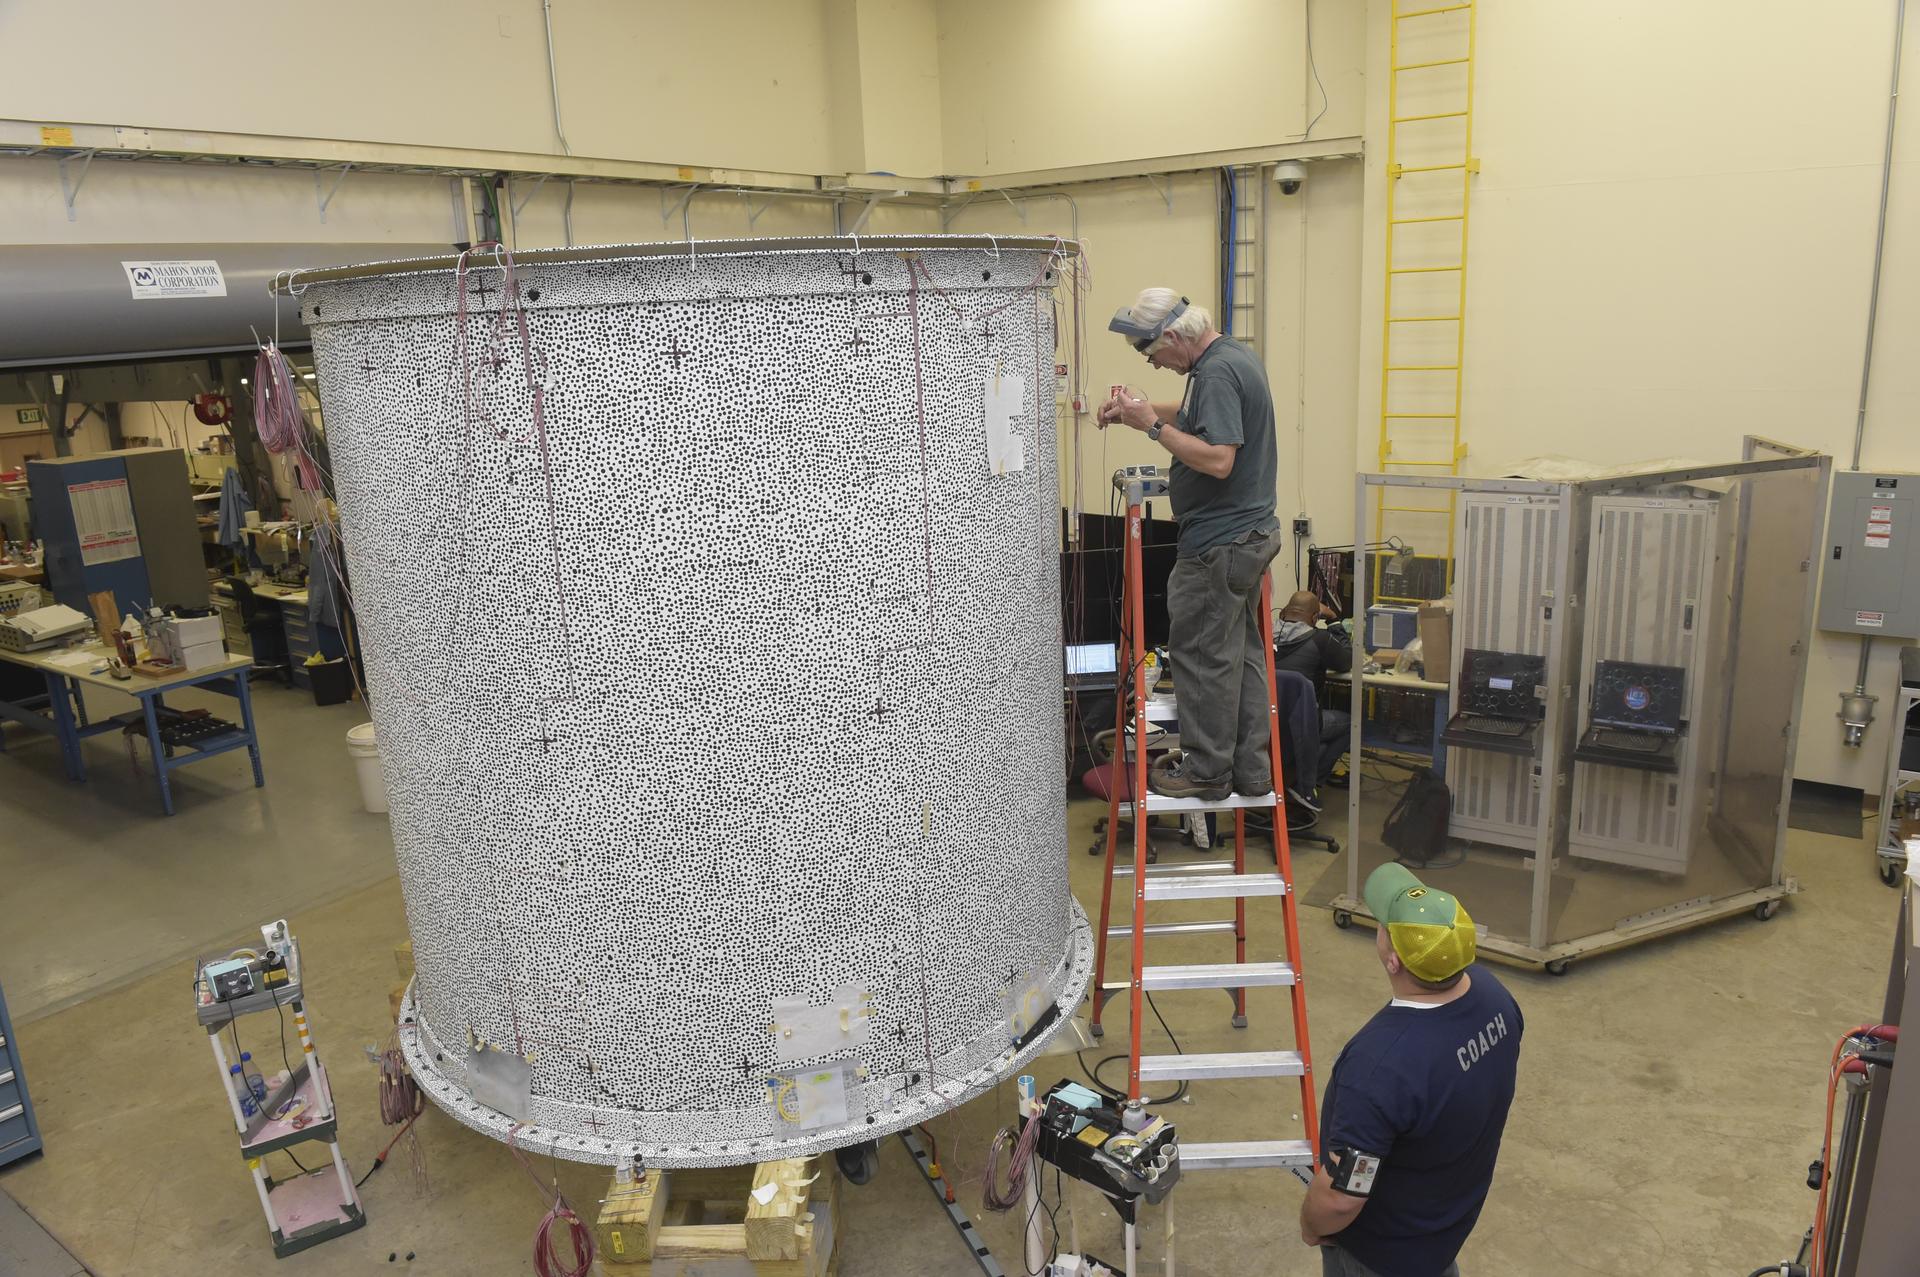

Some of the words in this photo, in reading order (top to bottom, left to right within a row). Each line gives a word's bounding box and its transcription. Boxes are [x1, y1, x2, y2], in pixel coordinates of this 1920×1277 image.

[153, 266, 189, 276] MAHON
[191, 266, 217, 275] DOOR
[158, 276, 219, 287] CORPORATION
[1457, 1012, 1507, 1071] COACH
